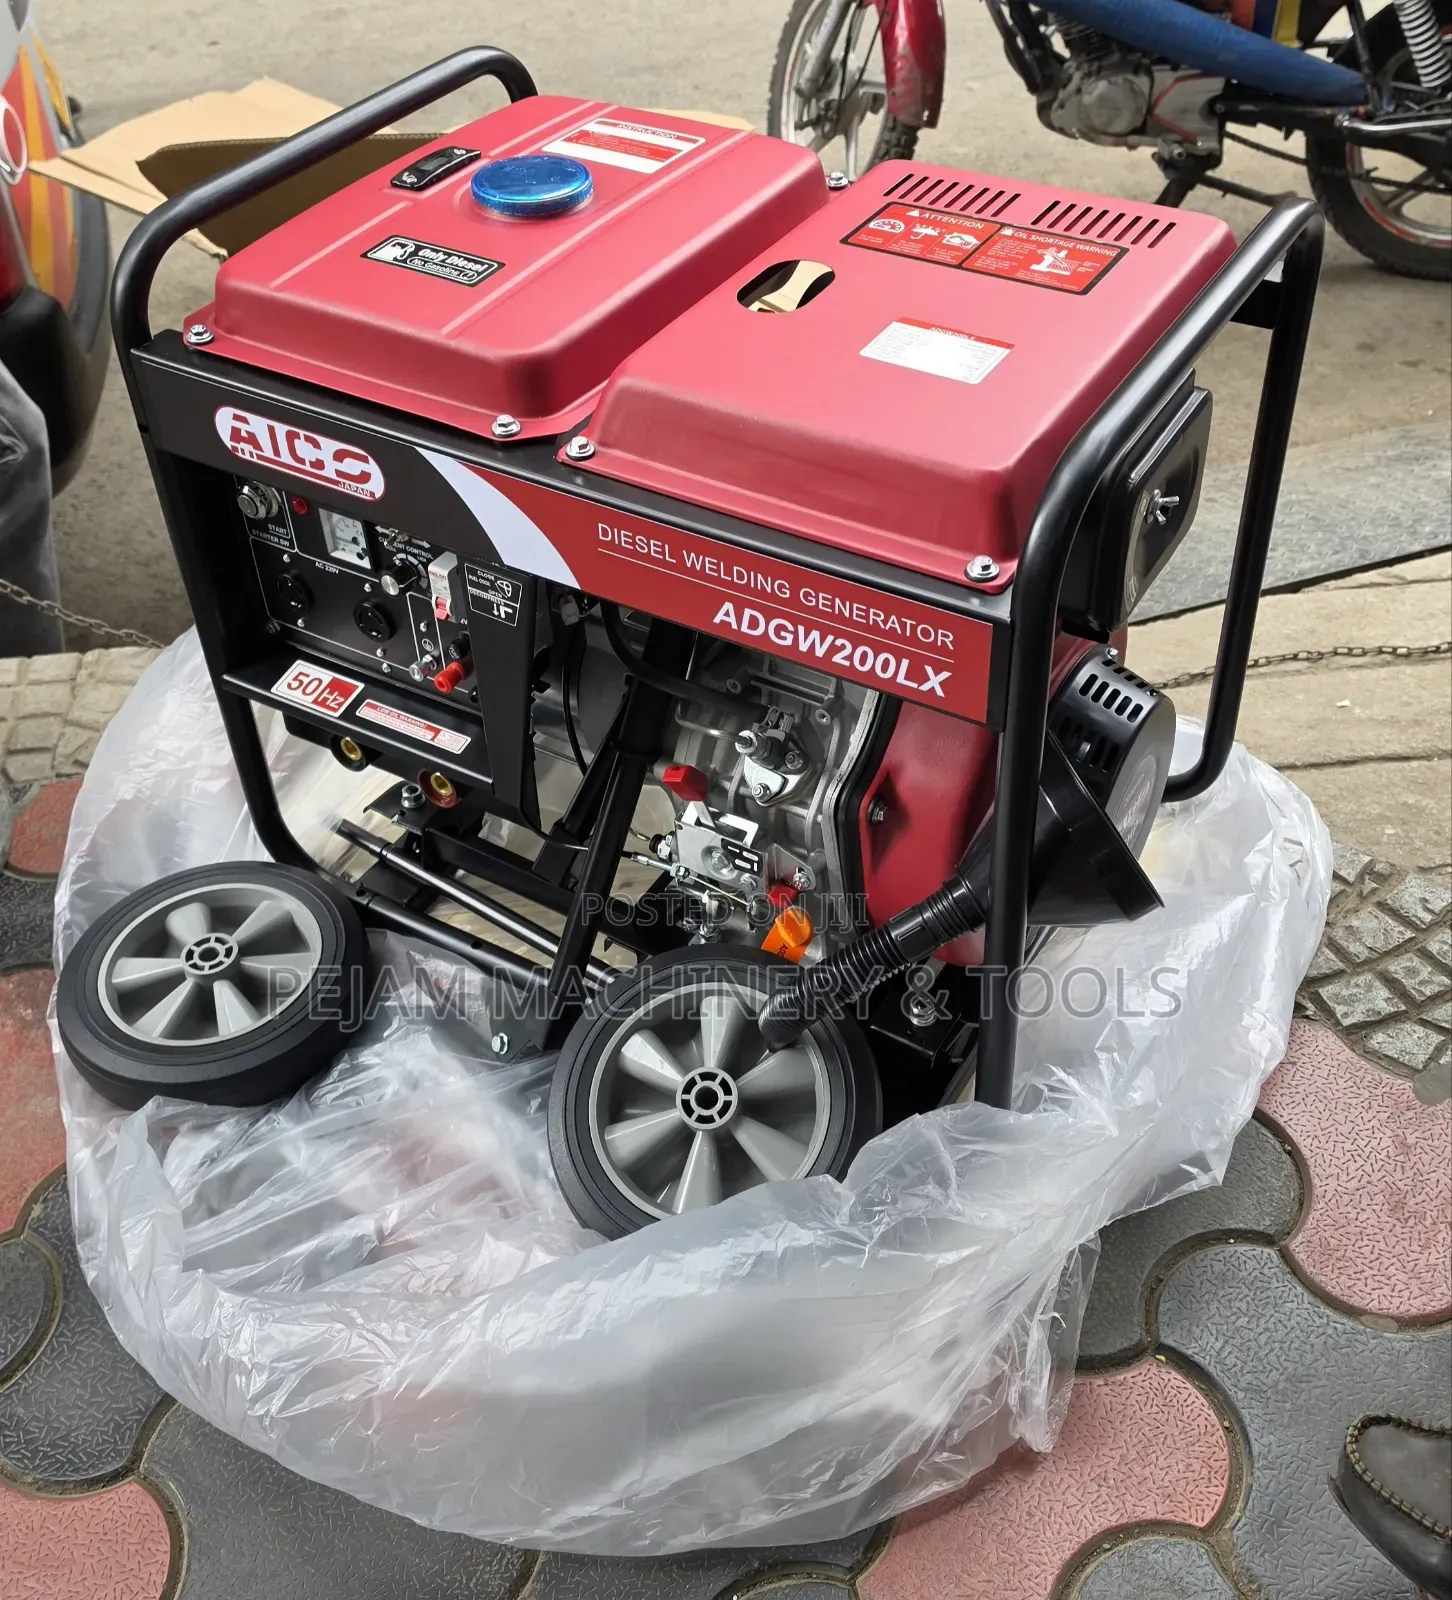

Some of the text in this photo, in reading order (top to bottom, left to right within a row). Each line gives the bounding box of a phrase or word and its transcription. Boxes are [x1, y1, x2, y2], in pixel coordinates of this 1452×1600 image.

[616, 123, 678, 139] INSTRUCTION
[921, 212, 985, 229] ATTENTION
[1013, 231, 1028, 239] OIL
[1029, 234, 1075, 248] SHORTAGE
[1075, 243, 1117, 257] WARNING
[411, 258, 460, 276] No Gasoline
[417, 248, 489, 272] Only Diesel
[338, 481, 371, 497] JAPAN
[252, 528, 280, 544] STARTER
[267, 523, 288, 535] START
[406, 545, 434, 560] CONTROL
[315, 562, 325, 571] AC
[468, 574, 478, 583] FUEL
[477, 570, 495, 581] CLOSE
[488, 589, 503, 599] OPEN
[597, 523, 955, 650] DIESEL WELDING GENERATOR
[713, 601, 952, 698] ADGW200LX
[287, 671, 345, 709] 50 Hz
[376, 706, 390, 715] LOW
[389, 711, 399, 719] OIL
